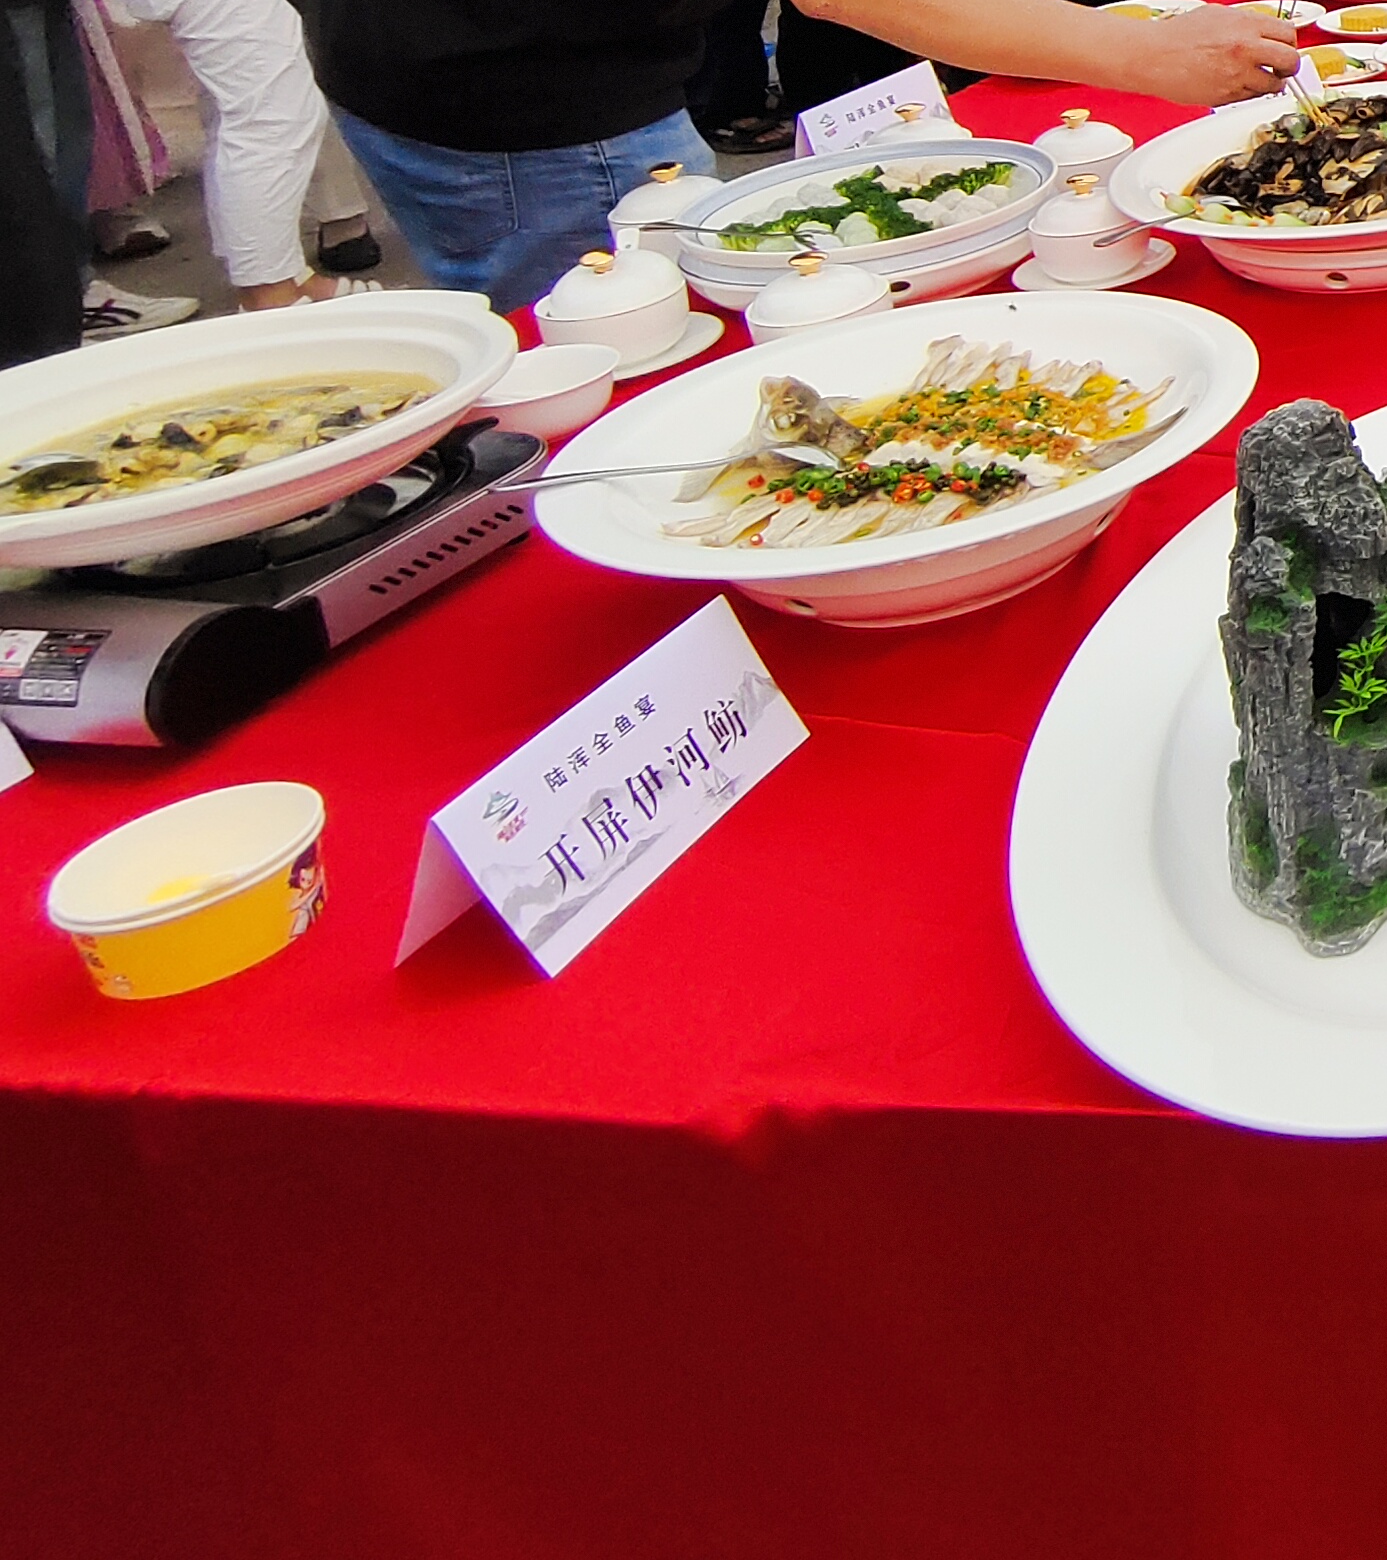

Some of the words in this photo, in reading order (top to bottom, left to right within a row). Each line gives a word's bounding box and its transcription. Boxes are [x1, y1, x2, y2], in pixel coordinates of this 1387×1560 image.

[538, 700, 748, 896] 开屏伊河鲂
[543, 694, 657, 793] 陆浑全鱼宴
